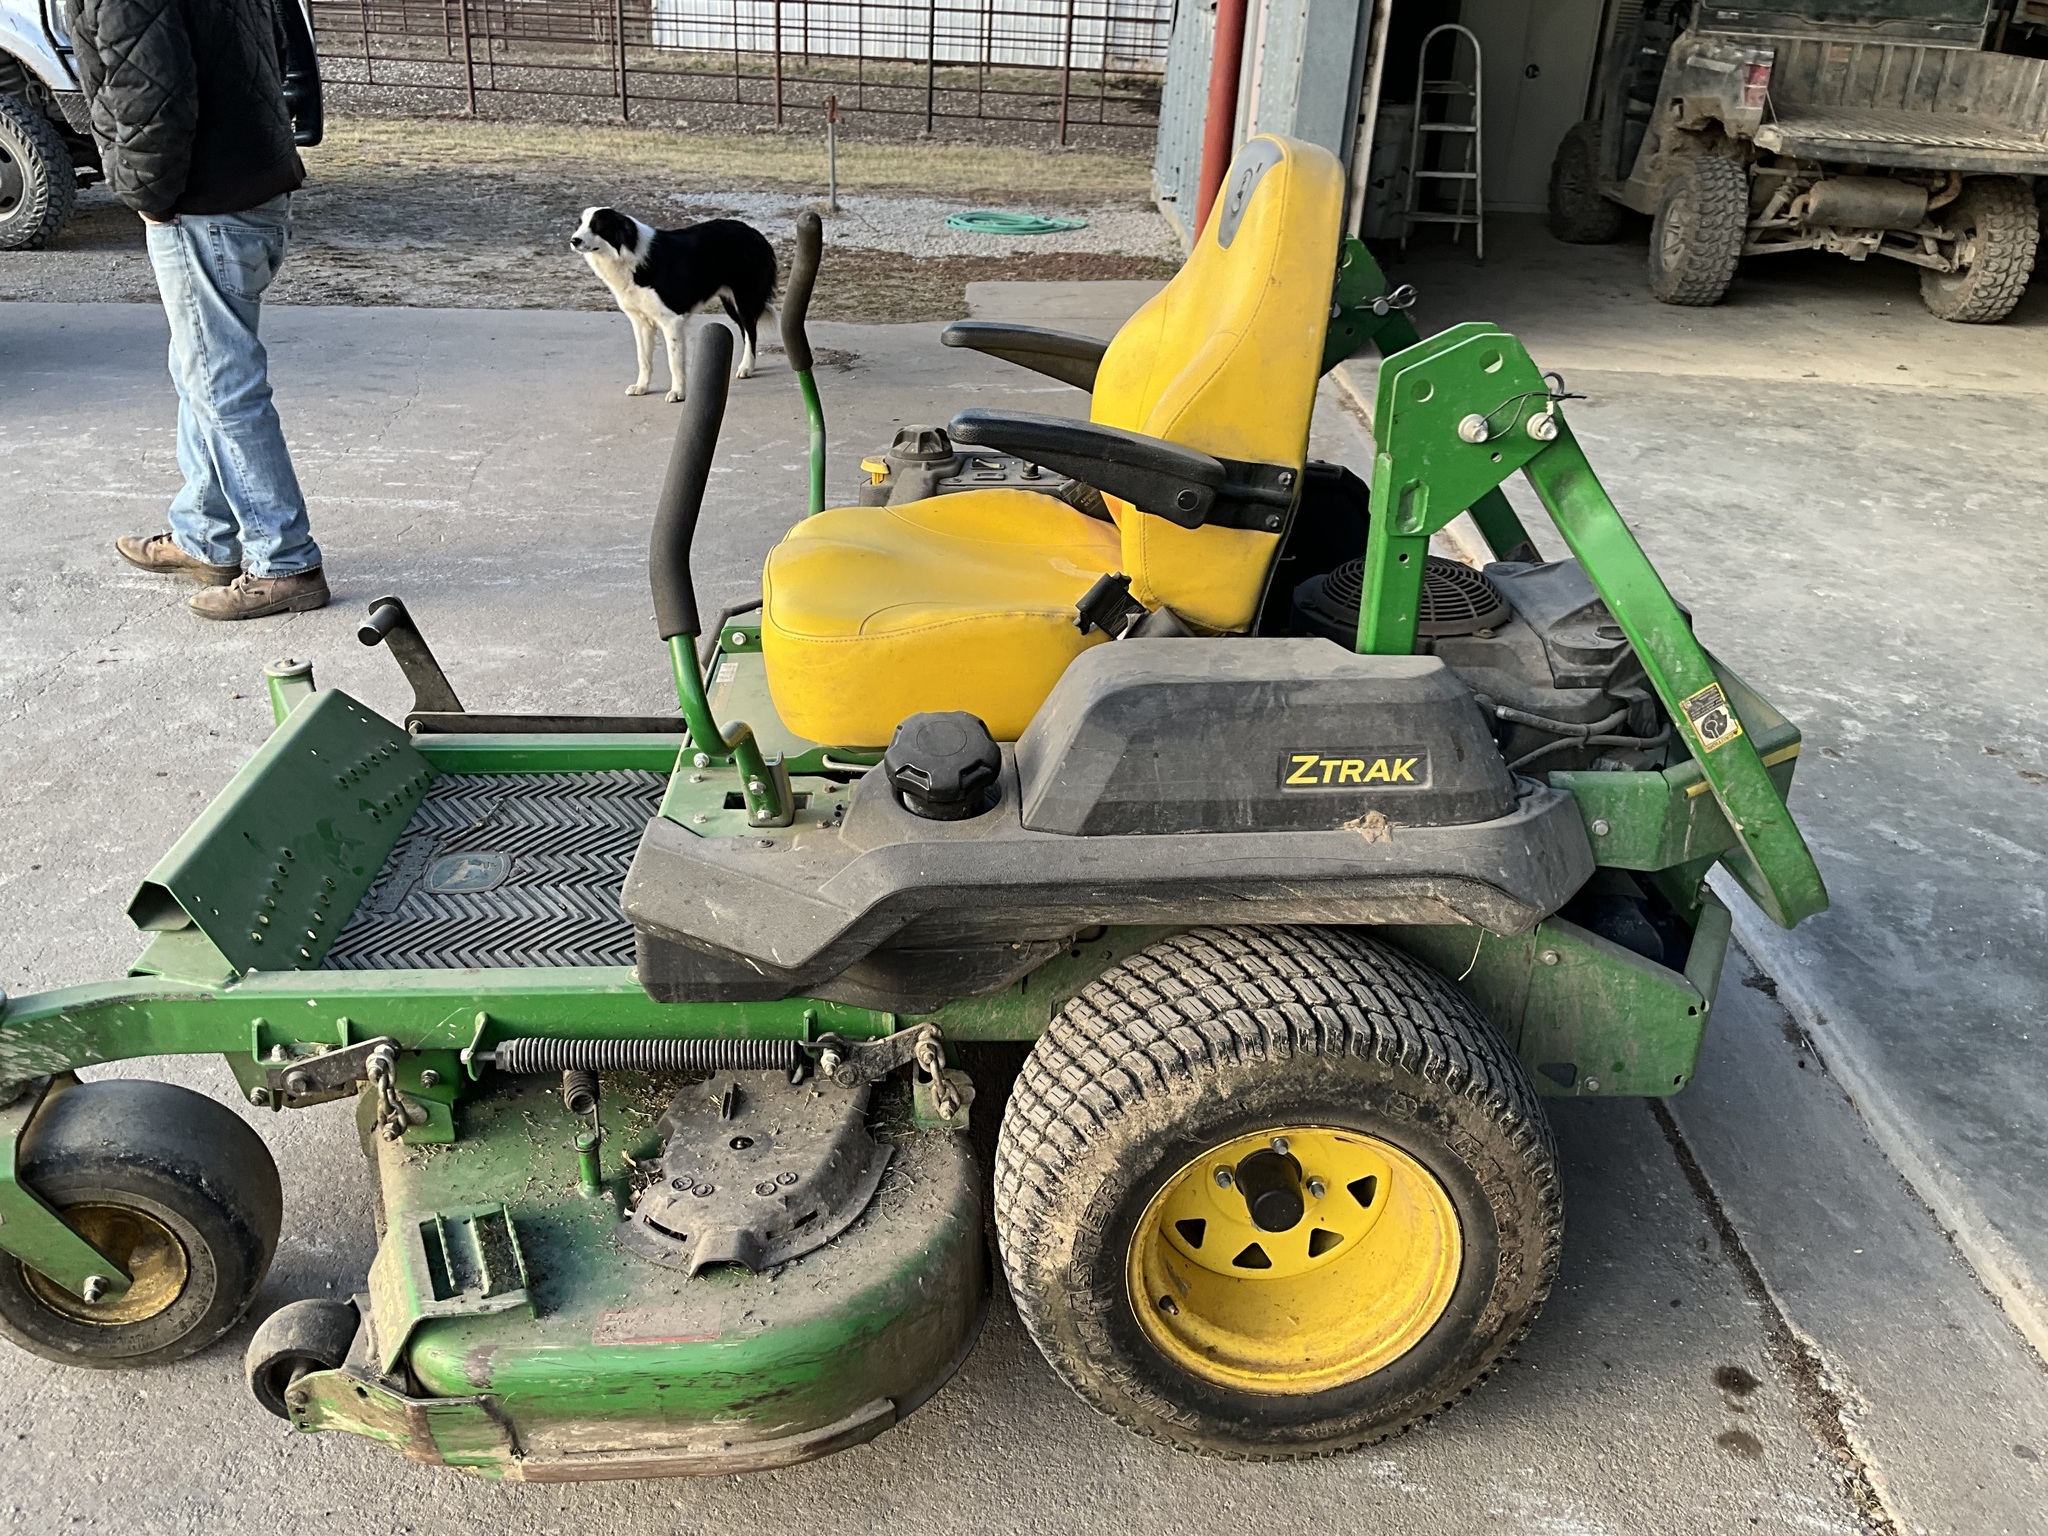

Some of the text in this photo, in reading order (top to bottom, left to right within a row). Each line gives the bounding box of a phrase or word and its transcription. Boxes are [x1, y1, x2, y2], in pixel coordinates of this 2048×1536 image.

[1285, 755, 1418, 784] ZTRAK
[1068, 1177, 1202, 1431] TURF MASTER
